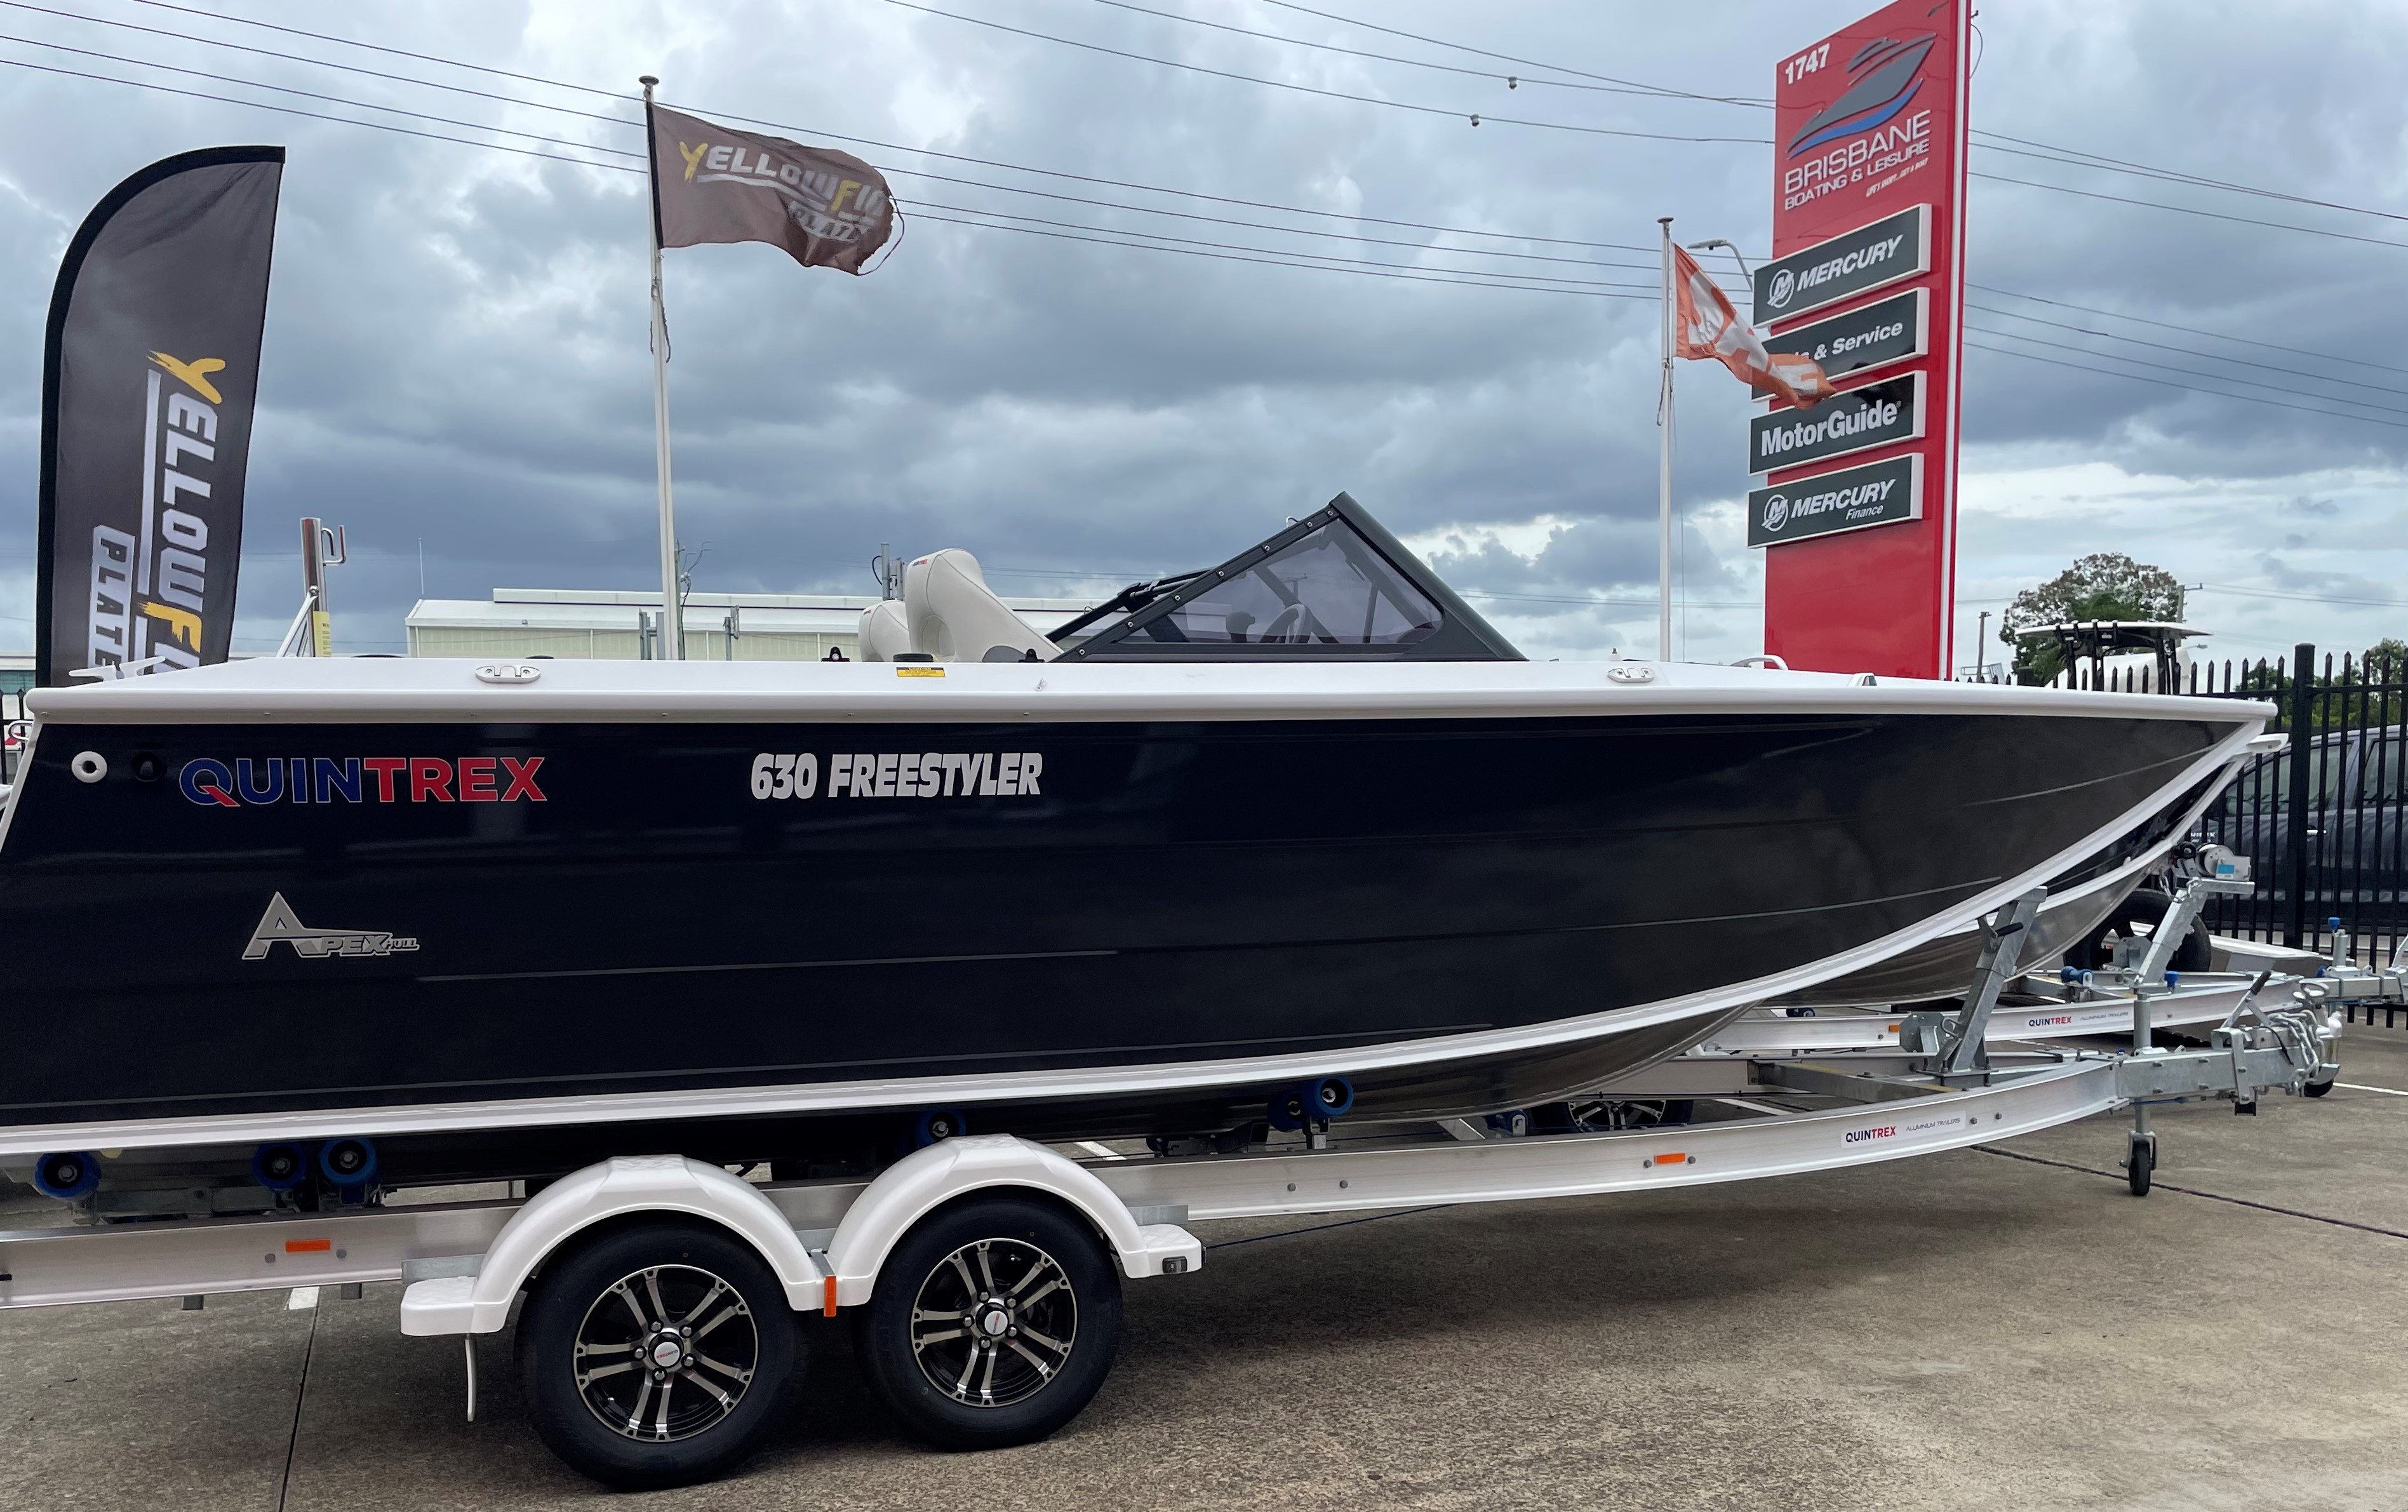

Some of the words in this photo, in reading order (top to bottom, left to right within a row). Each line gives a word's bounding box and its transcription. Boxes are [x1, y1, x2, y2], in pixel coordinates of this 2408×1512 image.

[1785, 43, 1830, 85] 1747
[1785, 109, 1931, 194] BRISBANE
[1785, 174, 1849, 210] BOATING
[1851, 168, 1864, 182] &
[1867, 138, 1930, 177] LEISURE
[679, 141, 889, 218] YELLOWFIN
[1796, 234, 1904, 292] MERCURY
[1814, 344, 1828, 361] &
[1832, 322, 1903, 355] Service
[1791, 478, 1896, 519] MERCURY
[1845, 504, 1884, 521] Finance
[178, 757, 548, 807] QUINTREX
[751, 753, 819, 800] 630
[827, 752, 1043, 798] FREESTYLER
[241, 891, 392, 960] APEX
[2029, 1016, 2072, 1027] QUINTREX
[1845, 1125, 1897, 1143] QUINTREX
[1906, 1121, 1936, 1132] ALUMINIUM
[1937, 1118, 1960, 1127] TRAILERS
